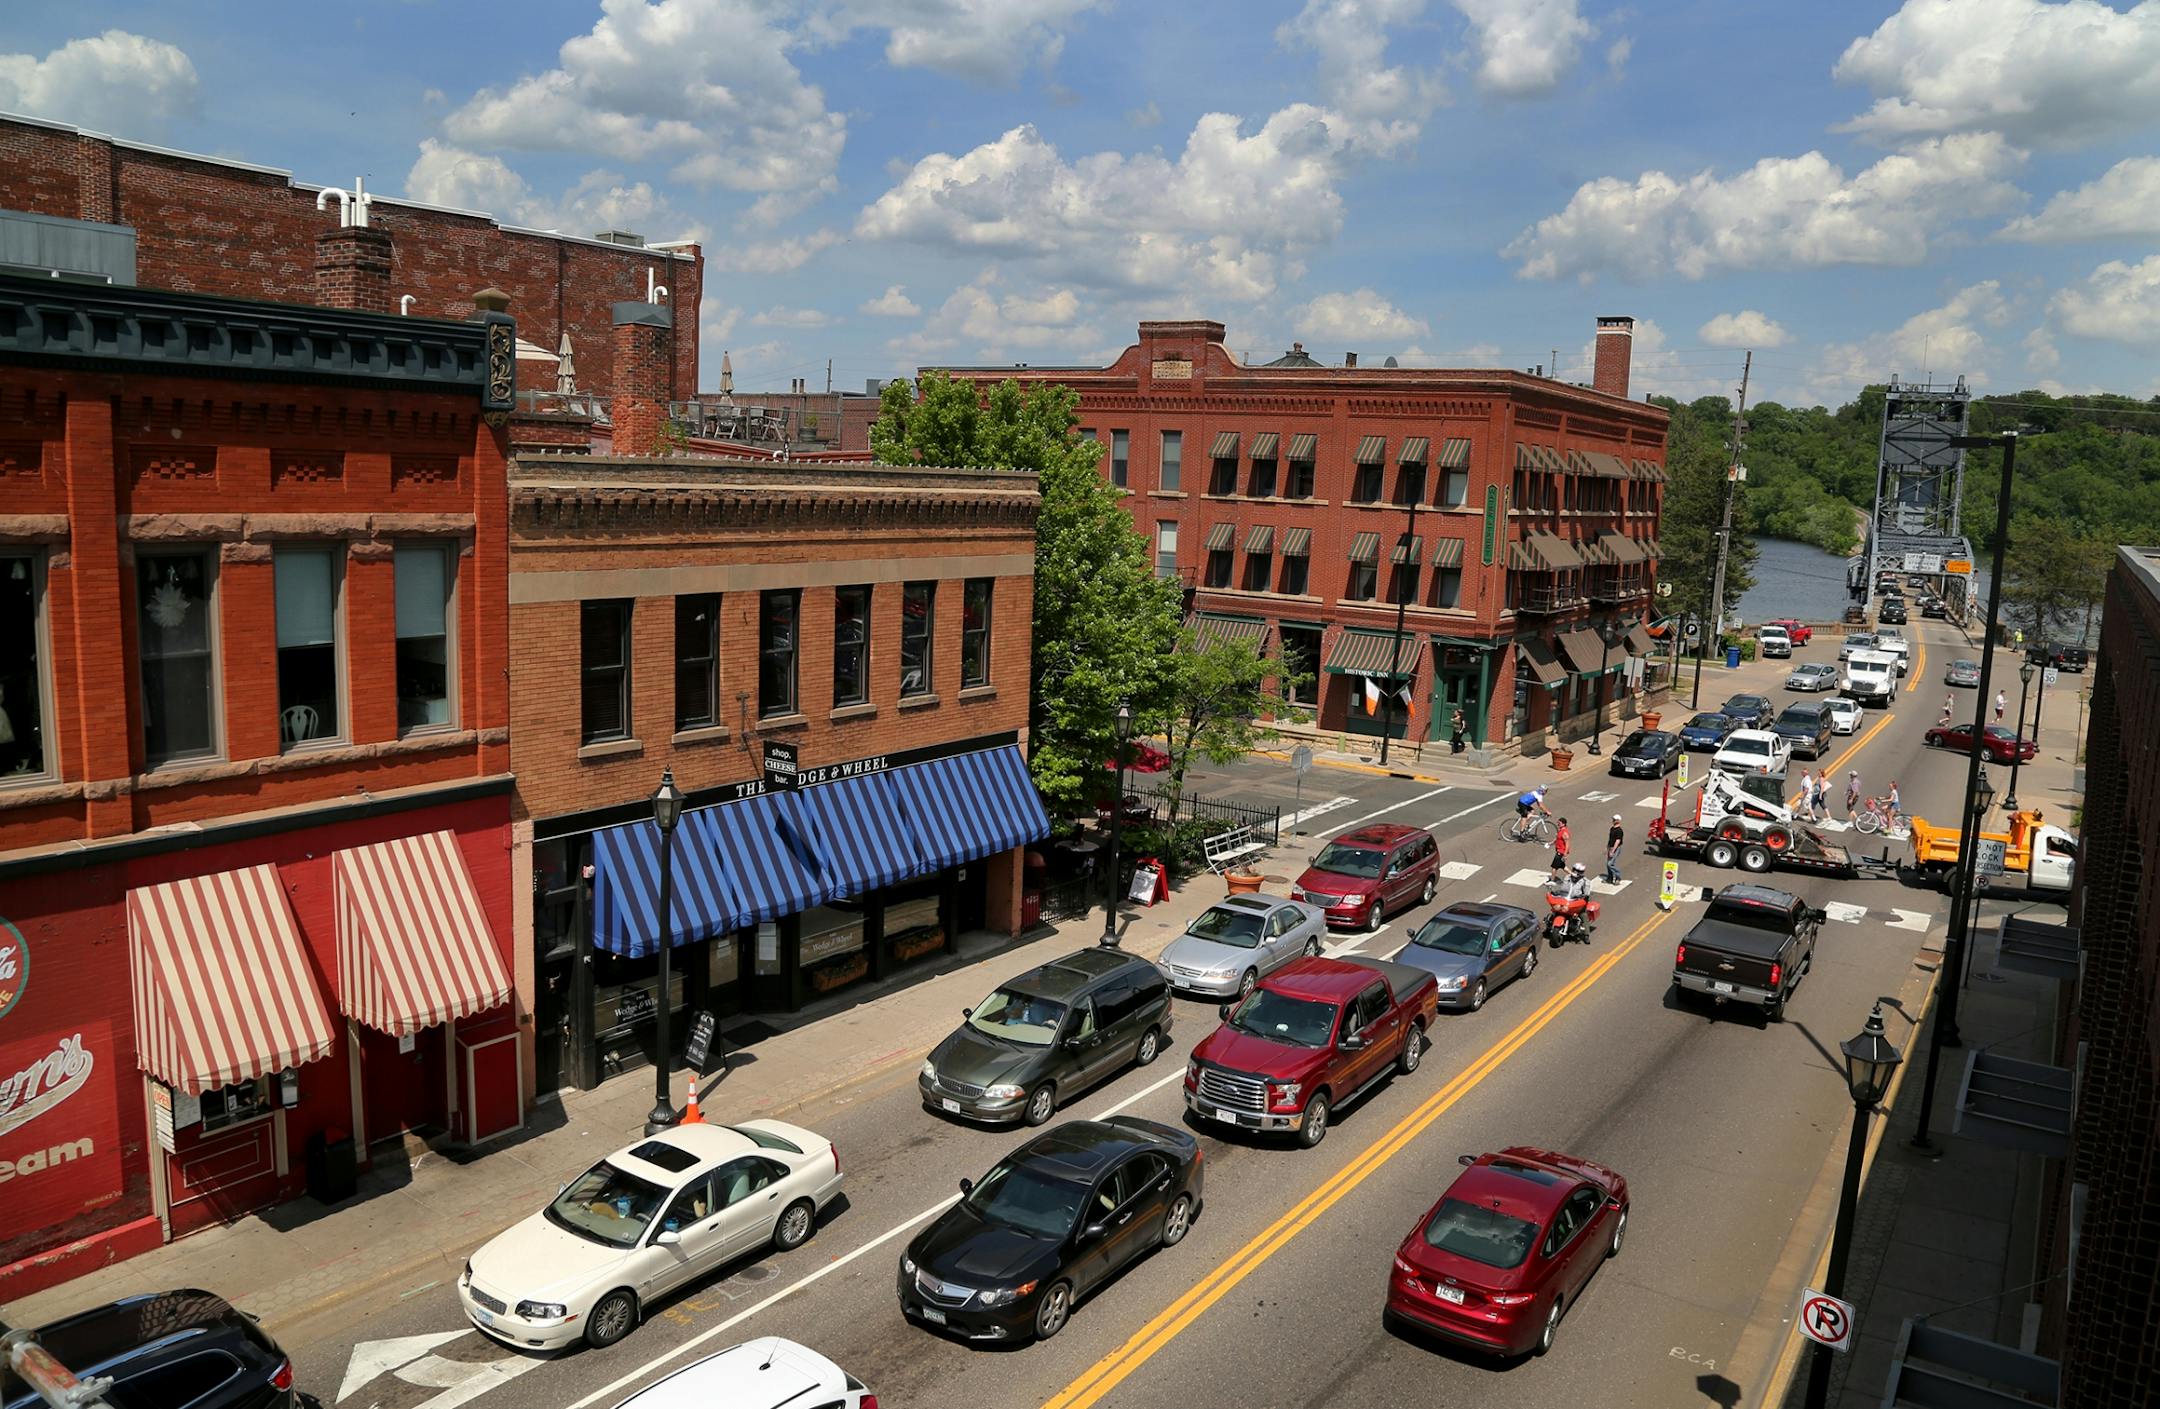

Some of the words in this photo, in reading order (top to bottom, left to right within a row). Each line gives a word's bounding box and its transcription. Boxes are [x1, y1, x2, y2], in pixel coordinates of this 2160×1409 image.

[1344, 668, 1376, 677] HISTORIC
[2045, 675, 2055, 683] 30
[771, 748, 791, 760] shop.
[764, 759, 797, 774] CHEESE
[735, 780, 766, 798] THE
[797, 768, 827, 786] DGE
[830, 766, 840, 779] &
[841, 757, 889, 777] WHEEL
[774, 773, 789, 785] bar.
[1985, 843, 2003, 853] NOT
[614, 1003, 638, 1017] Wedge
